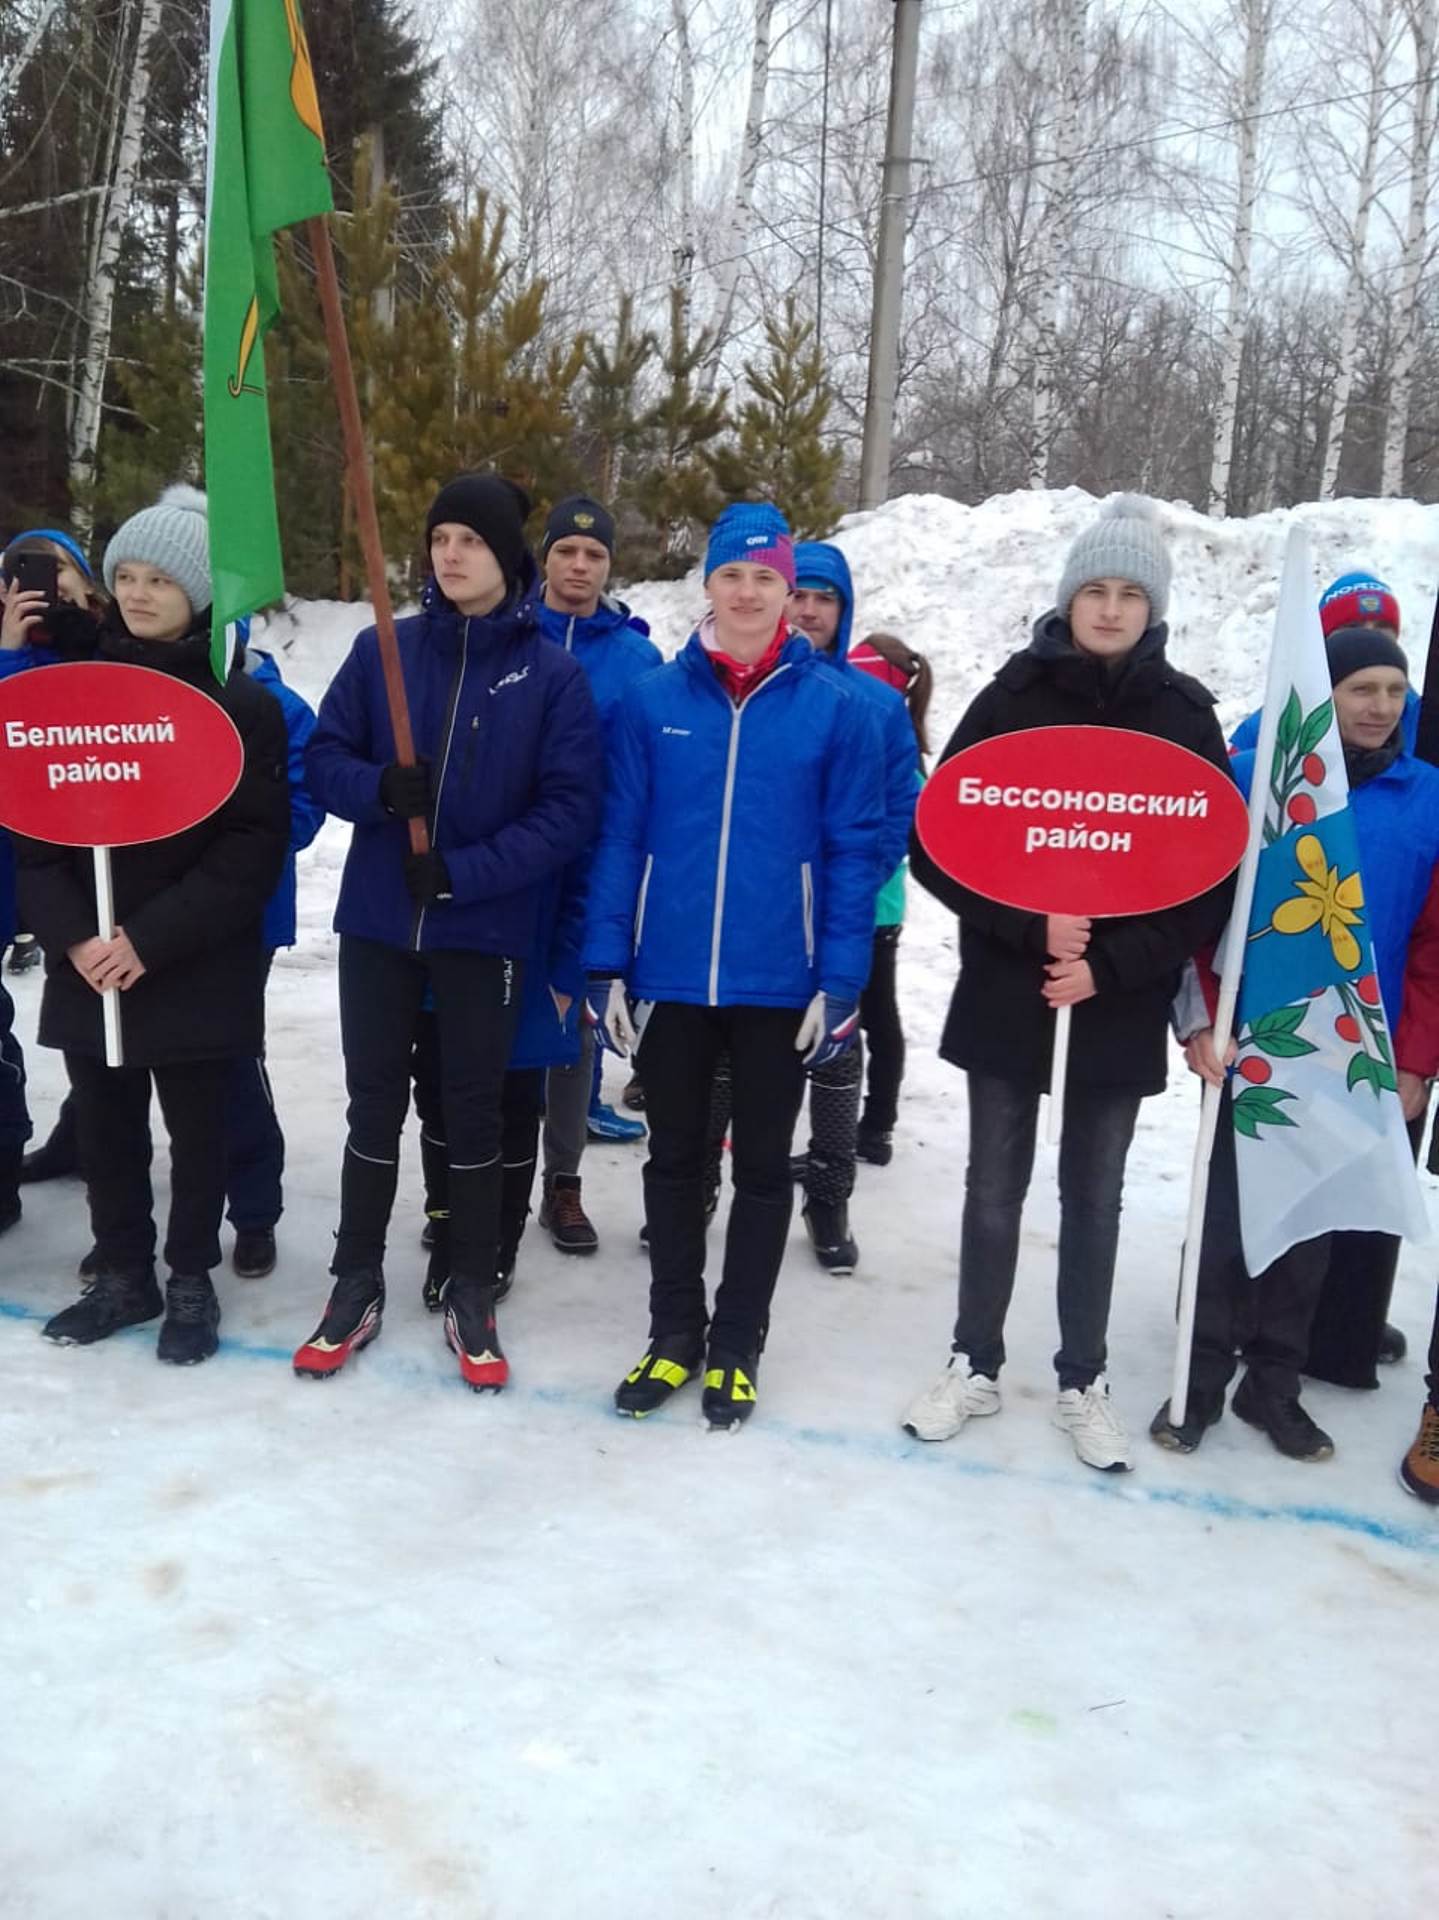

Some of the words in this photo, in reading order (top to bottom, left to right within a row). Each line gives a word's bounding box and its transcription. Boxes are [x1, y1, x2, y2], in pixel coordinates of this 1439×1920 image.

[5, 715, 175, 748] Белинский
[47, 755, 141, 790] район
[957, 777, 1209, 818] Бессоновский
[1024, 822, 1133, 853] район
